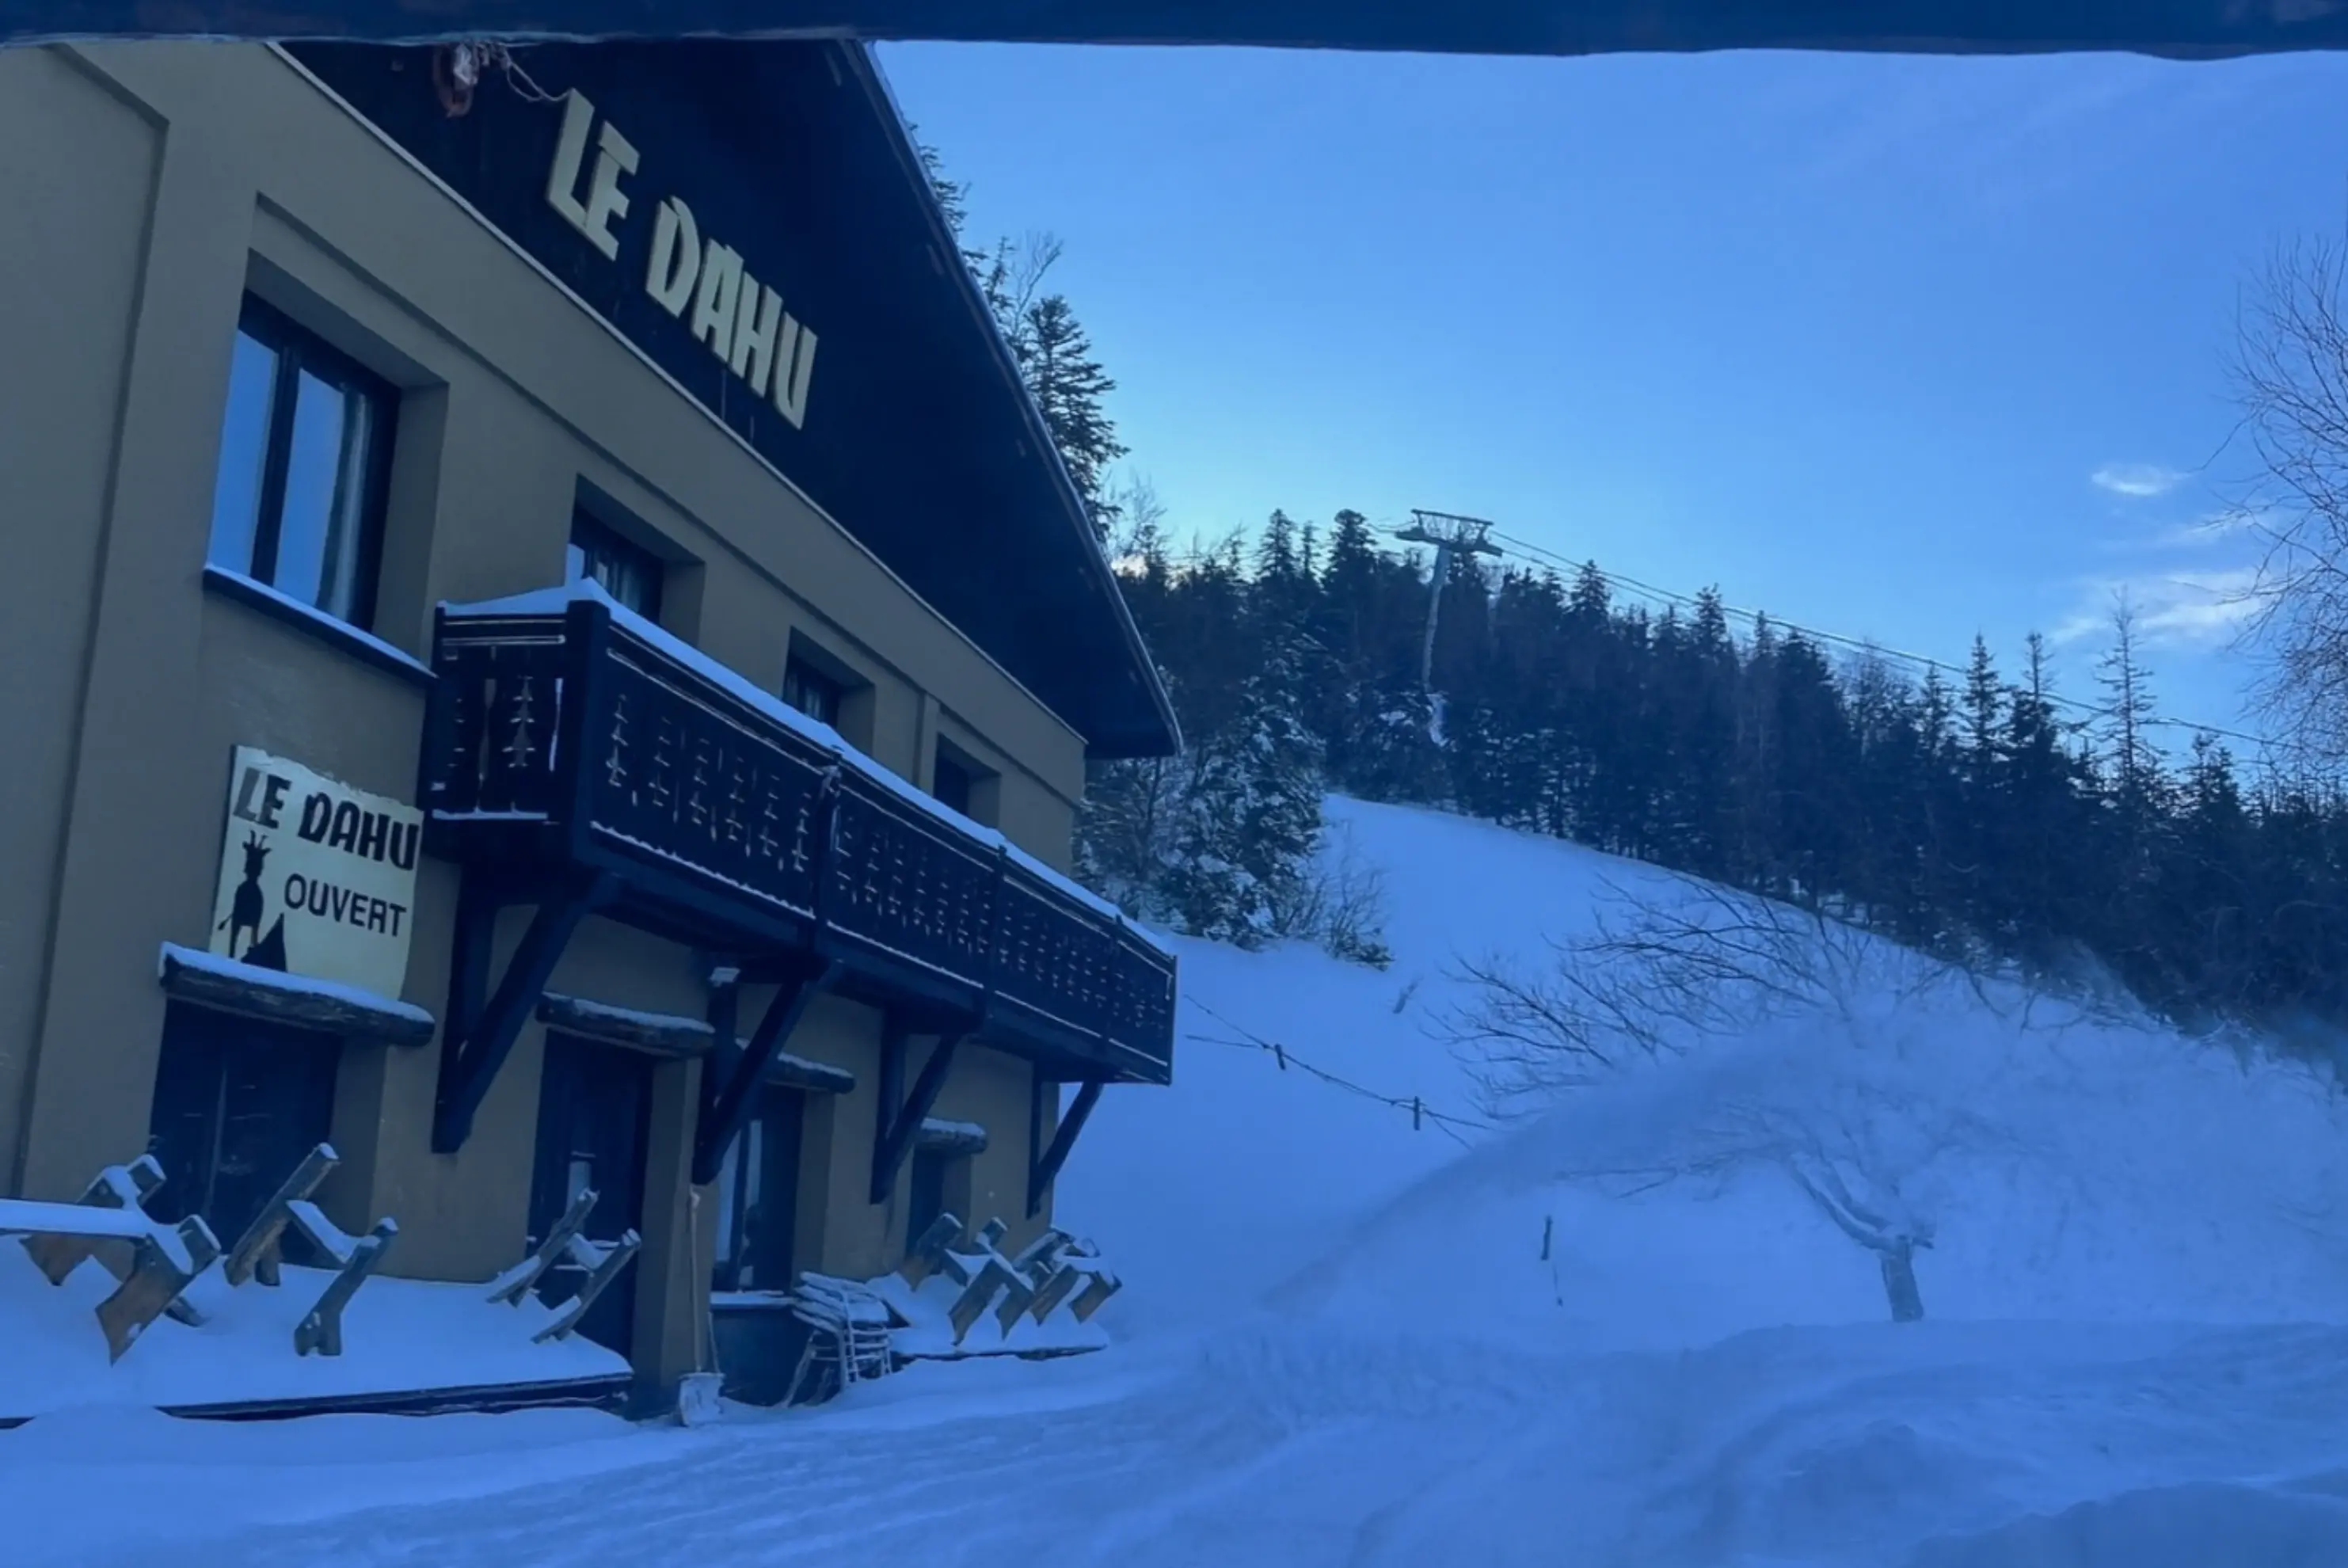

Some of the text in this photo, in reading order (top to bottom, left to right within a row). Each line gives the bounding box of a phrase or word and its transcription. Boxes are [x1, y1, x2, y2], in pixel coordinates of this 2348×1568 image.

[546, 88, 818, 430] LE DAHU
[233, 767, 419, 870] LE DAHU
[284, 873, 407, 938] OUVERT
